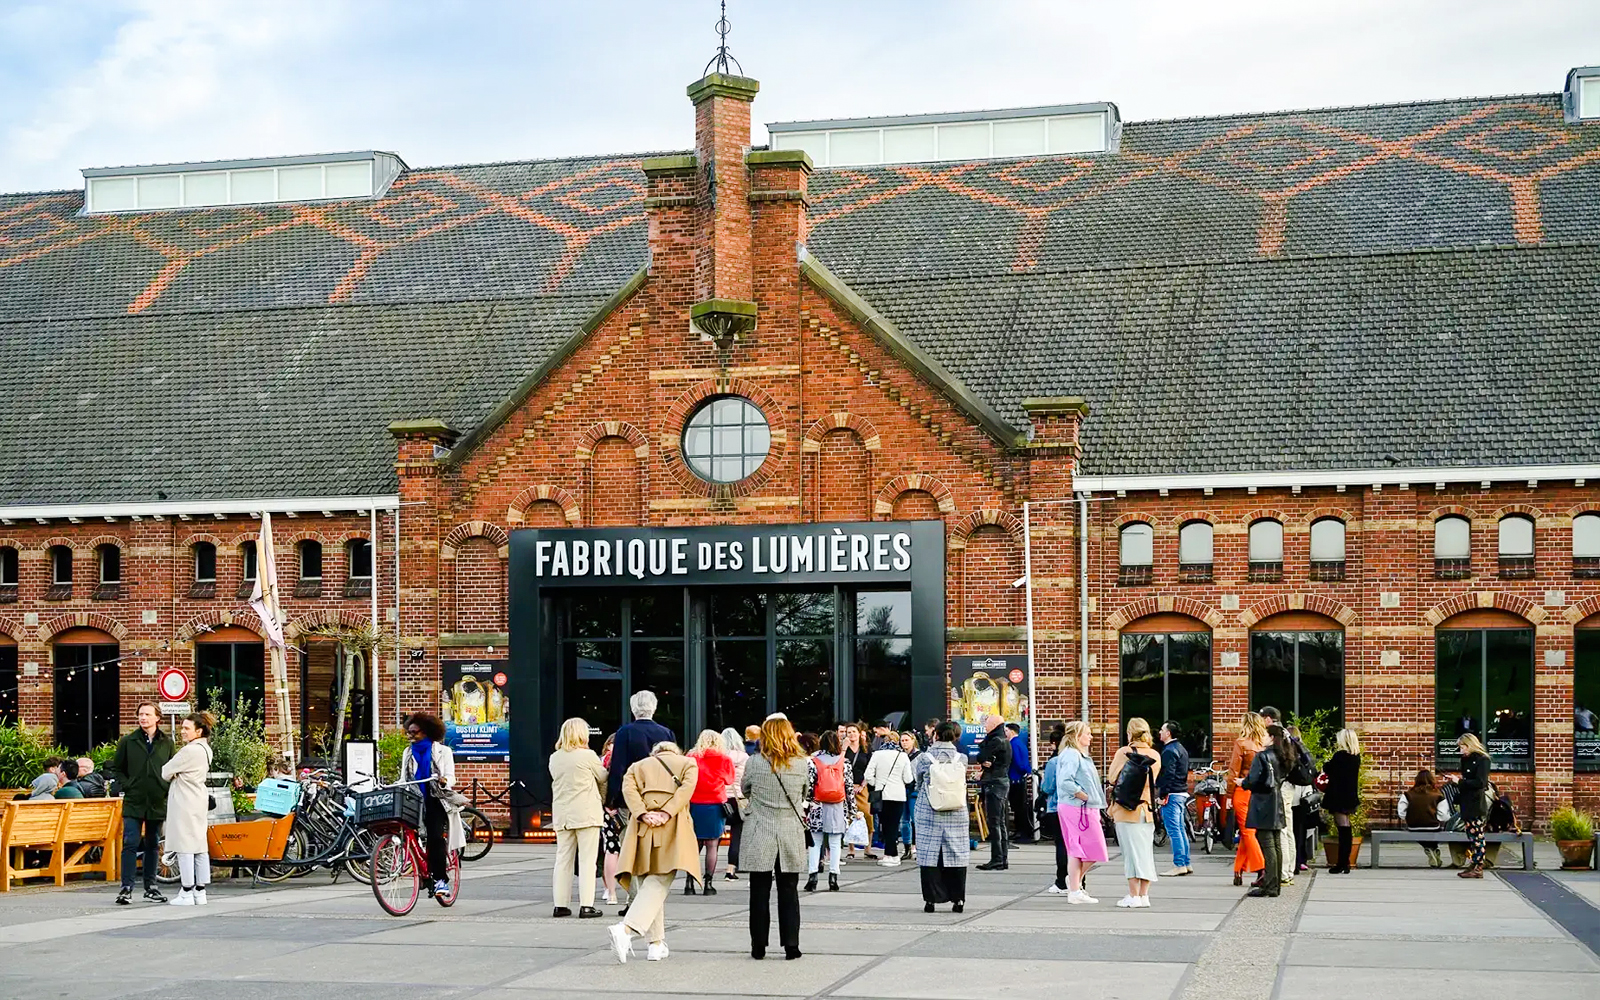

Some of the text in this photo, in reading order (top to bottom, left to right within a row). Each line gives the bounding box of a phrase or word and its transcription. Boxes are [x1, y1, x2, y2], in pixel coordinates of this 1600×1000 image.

[536, 528, 911, 580] FABRIQUE DES LUMIÈRES
[455, 725, 498, 734] GUSTAV KLIMT
[966, 725, 987, 734] GUSTA
